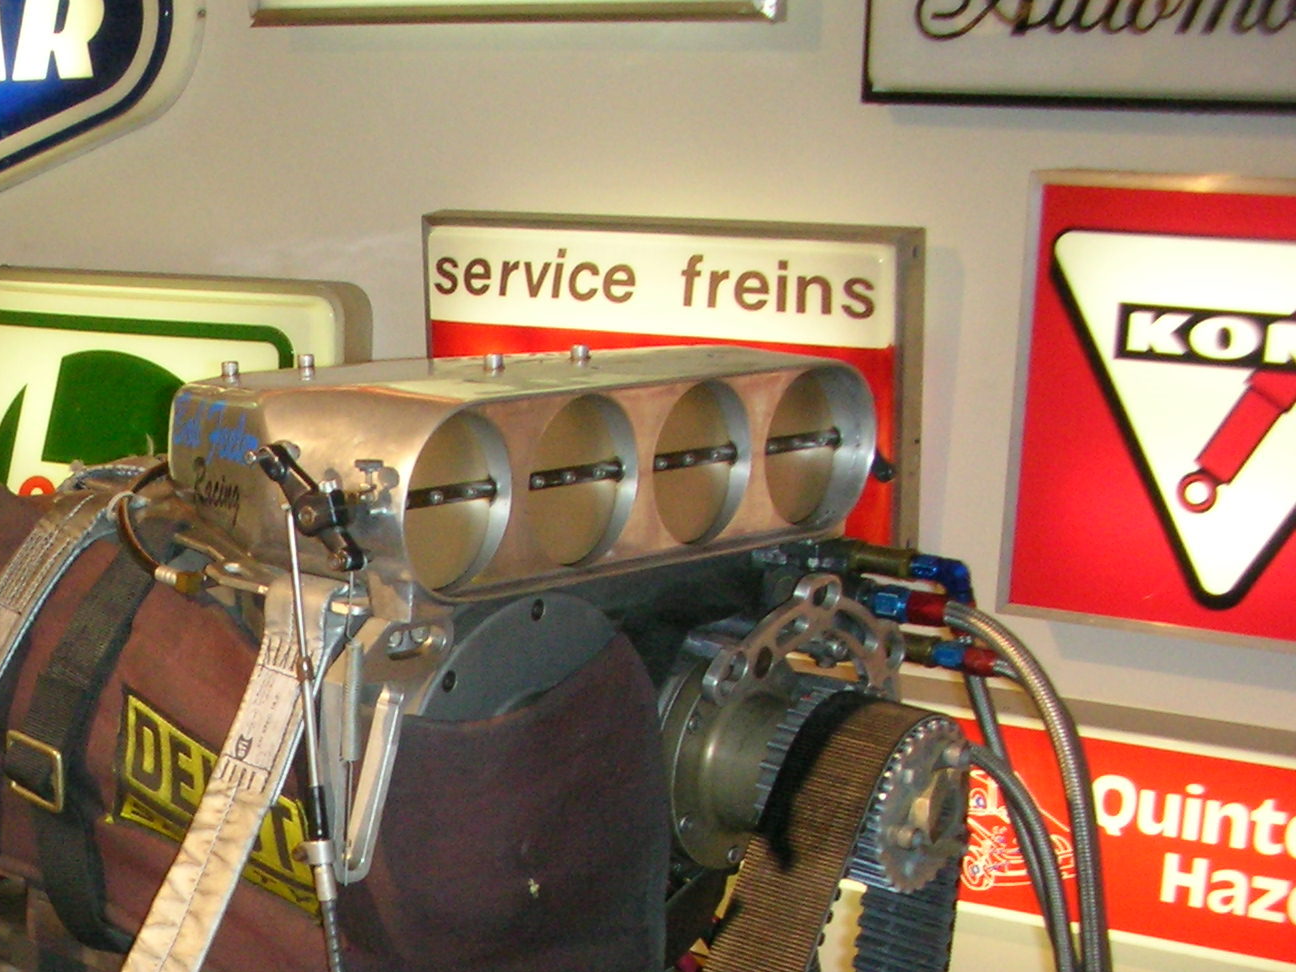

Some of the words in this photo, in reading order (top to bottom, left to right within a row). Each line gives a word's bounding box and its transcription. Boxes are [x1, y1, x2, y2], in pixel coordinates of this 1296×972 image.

[433, 248, 637, 303] service
[680, 254, 876, 320] freins
[1091, 774, 1296, 861] Quint
[1160, 852, 1296, 929] Haz
